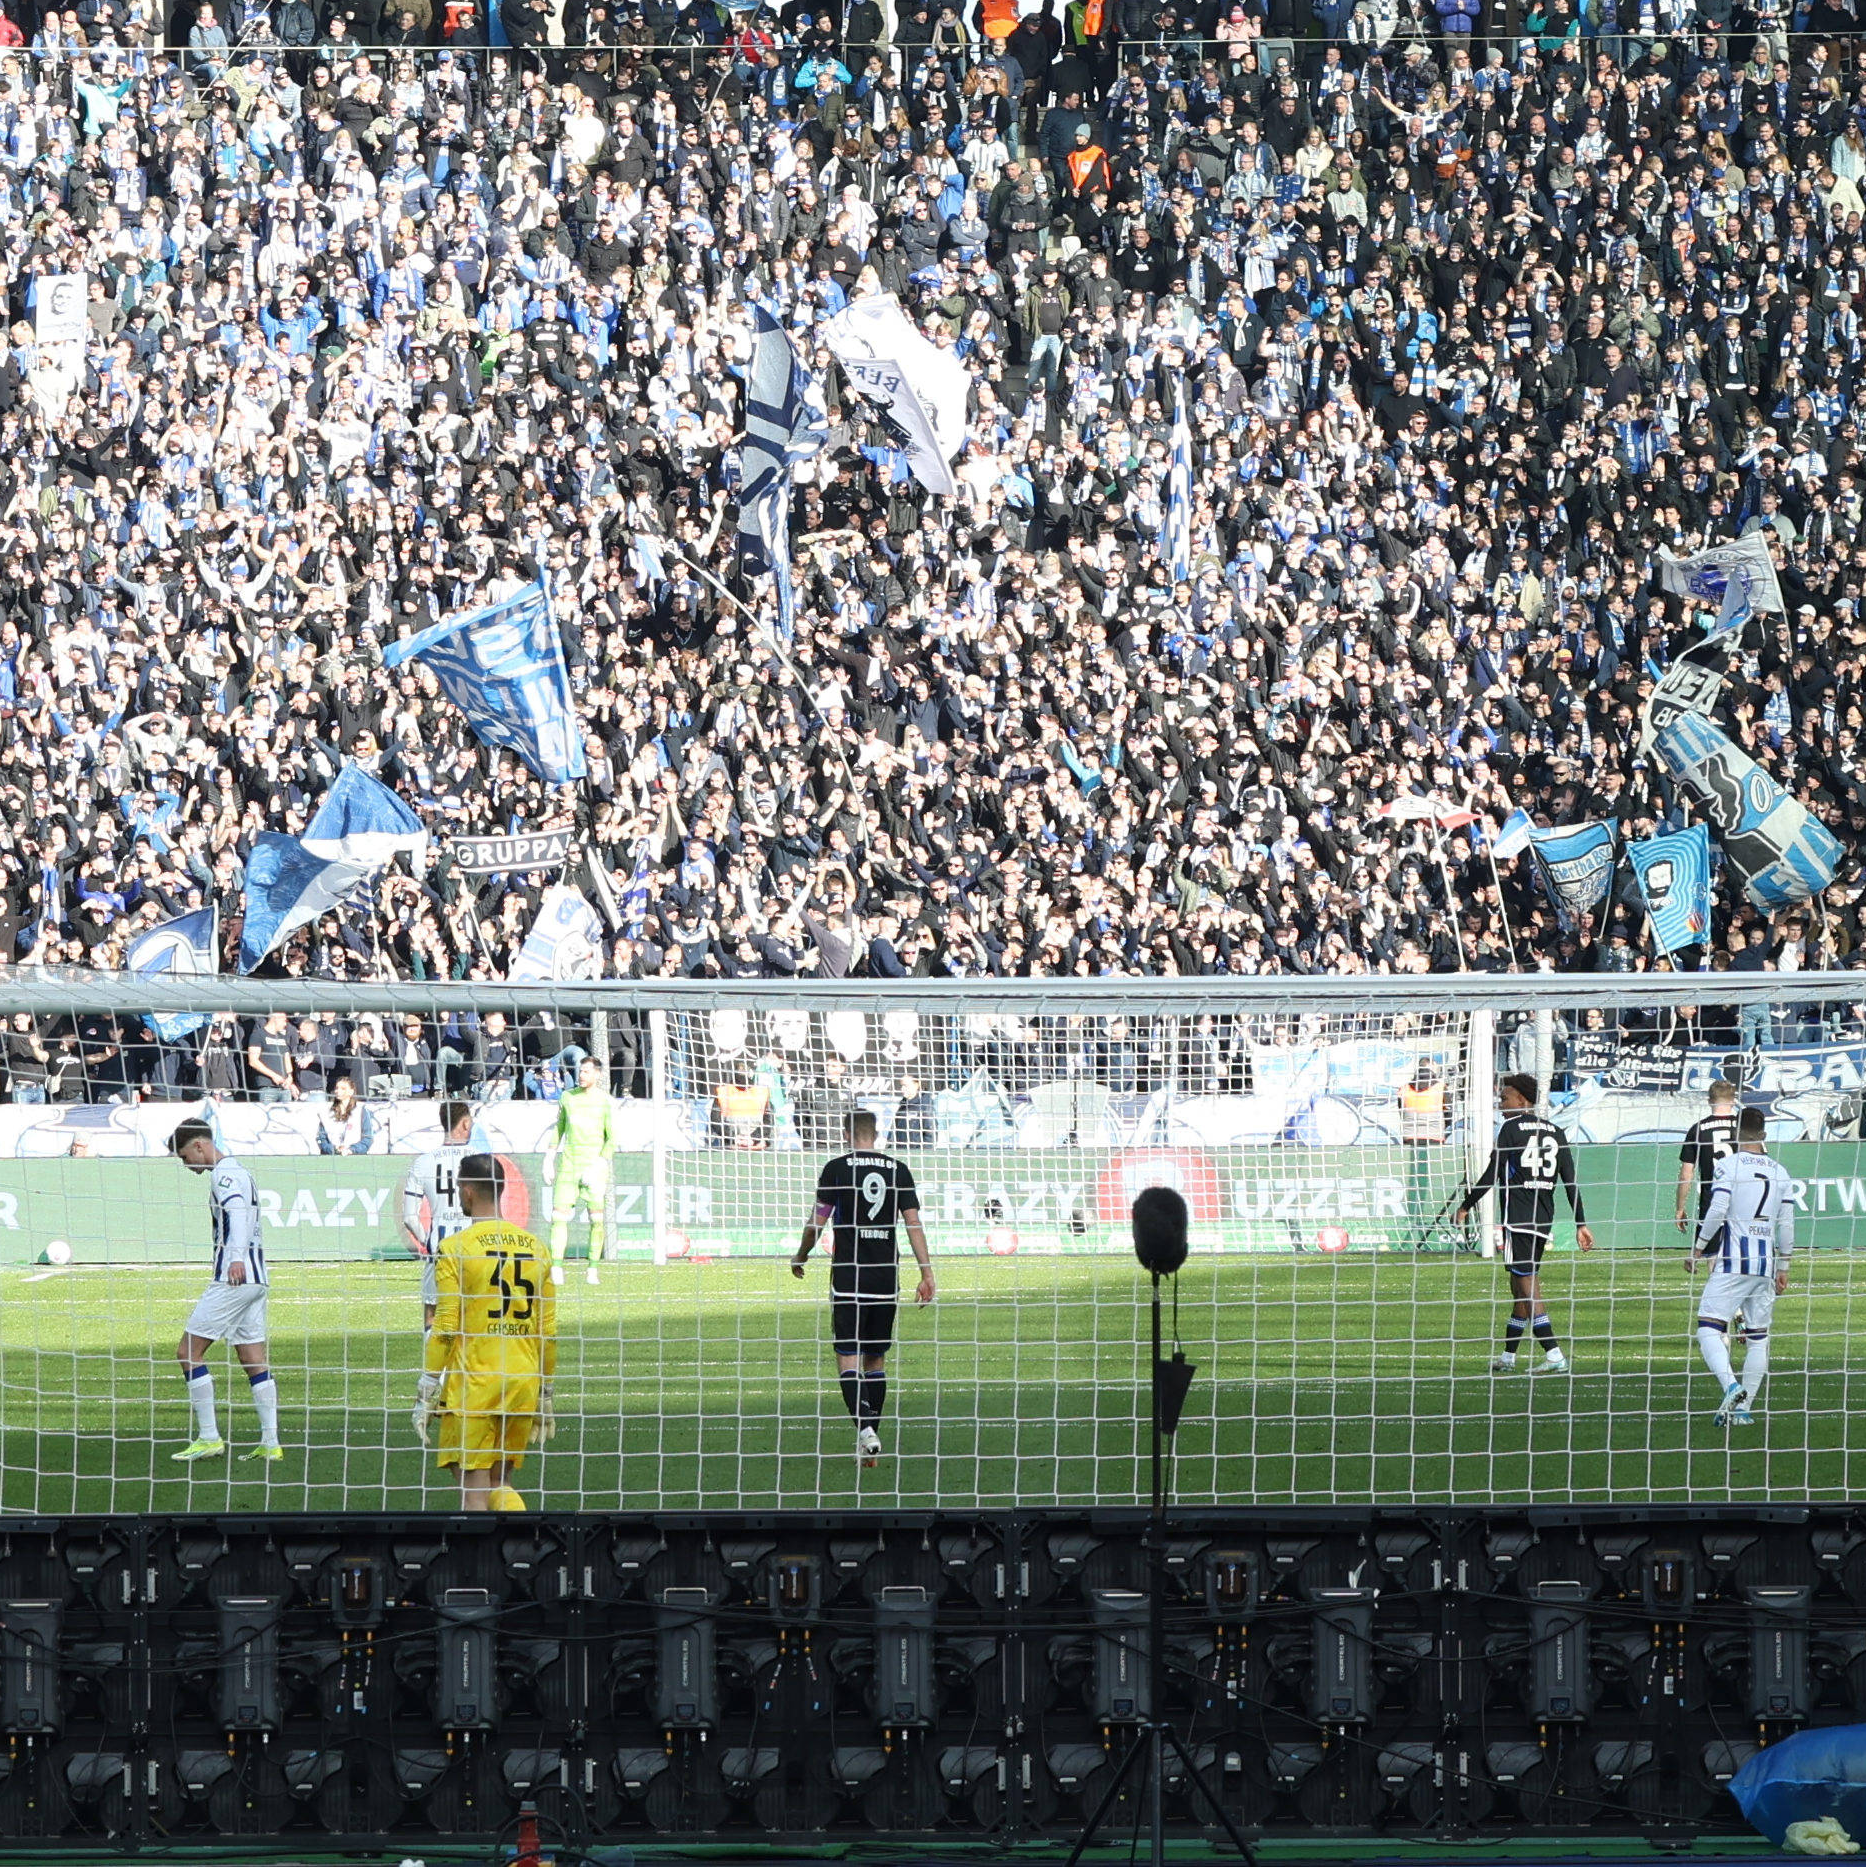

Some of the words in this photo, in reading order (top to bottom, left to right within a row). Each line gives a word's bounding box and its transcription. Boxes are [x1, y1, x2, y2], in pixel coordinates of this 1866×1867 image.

[846, 1157, 885, 1169] SCHALKE
[1520, 1135, 1560, 1178] 43
[862, 1171, 887, 1222] 9
[1753, 1172, 1771, 1222] 2
[485, 1249, 535, 1321] 35
